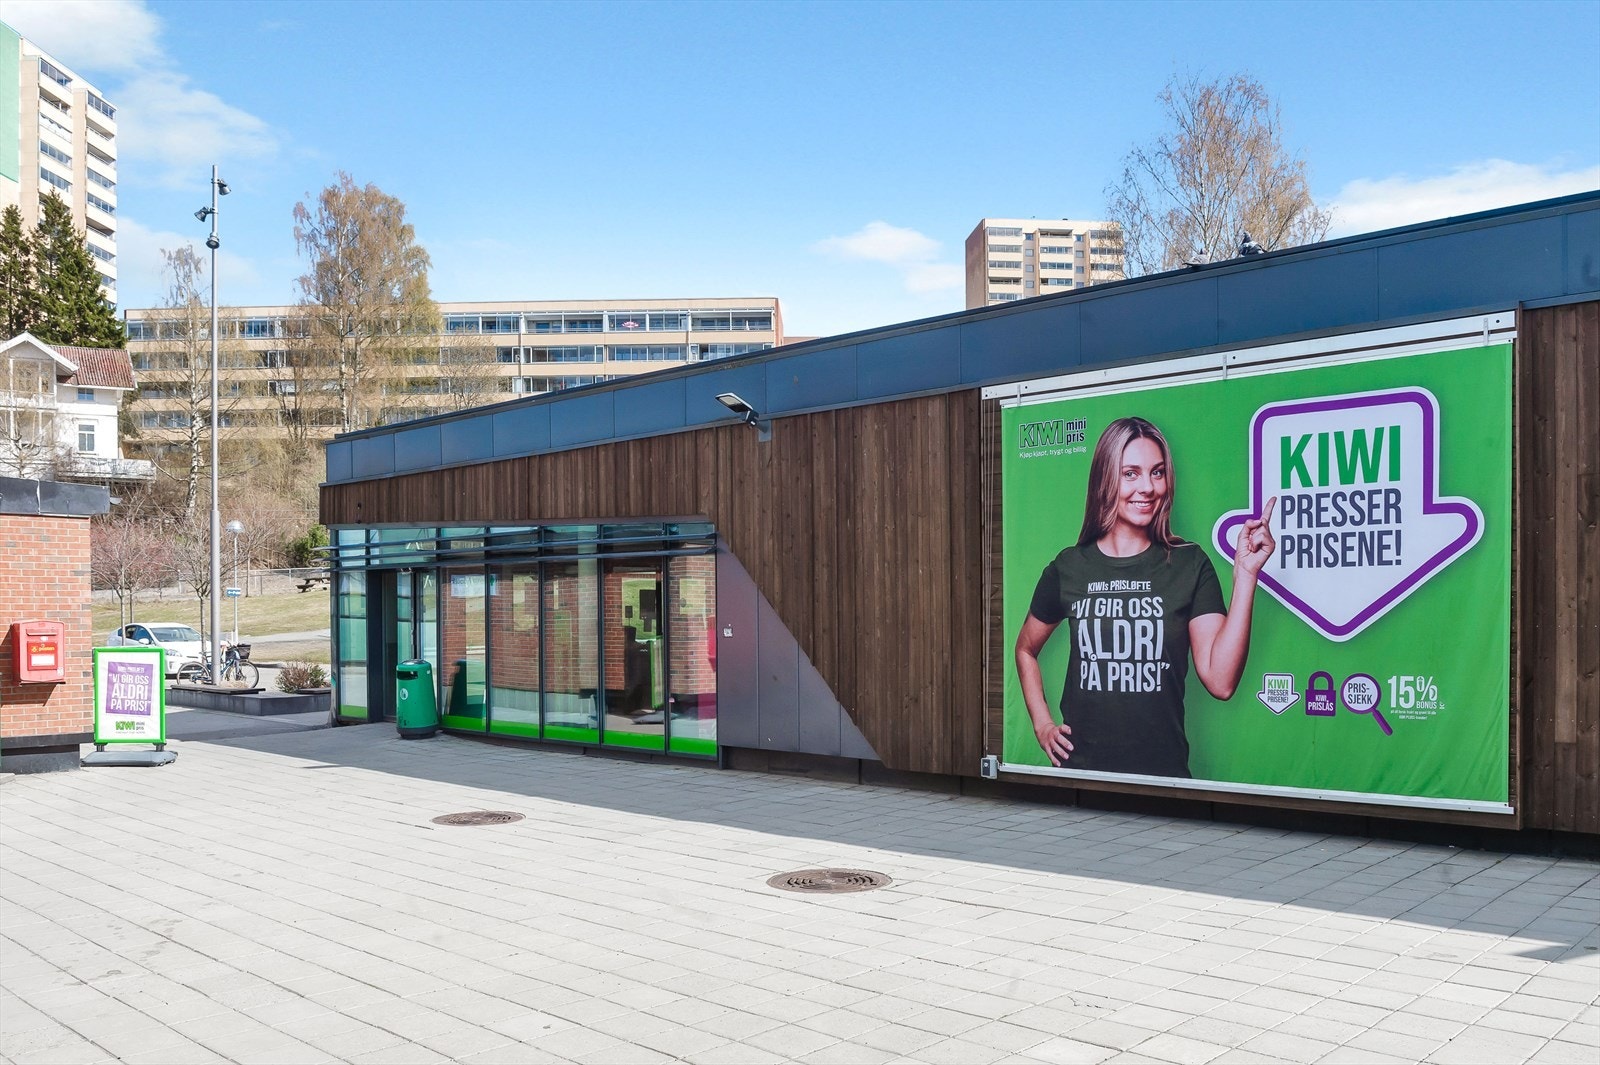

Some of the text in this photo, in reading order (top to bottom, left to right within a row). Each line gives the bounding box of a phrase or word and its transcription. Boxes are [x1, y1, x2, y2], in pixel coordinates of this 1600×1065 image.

[1066, 417, 1086, 431] mini
[1019, 420, 1064, 448] KIWI
[1066, 430, 1085, 446] pris
[1280, 425, 1401, 490] KIWI
[1280, 488, 1402, 530] PRESSER
[1280, 529, 1402, 569] PRISENE!
[1087, 580, 1151, 592] KIWIs PRISLØFTE
[1094, 598, 1123, 618] GIR
[1128, 596, 1164, 618] OSS
[1078, 618, 1164, 660] ALDRI
[121, 674, 134, 684] GIR
[134, 675, 149, 685] OSS
[1080, 654, 1102, 691] PÅ
[112, 683, 149, 700] ALDRI
[1267, 679, 1289, 689] KIWI
[1347, 682, 1370, 693] PRIS-
[1387, 675, 1438, 709] 15%
[1267, 689, 1289, 697] PRESSER
[1347, 693, 1373, 705] SJEKK
[1307, 700, 1334, 711] PRISLÅS
[1416, 701, 1437, 709] BONUS
